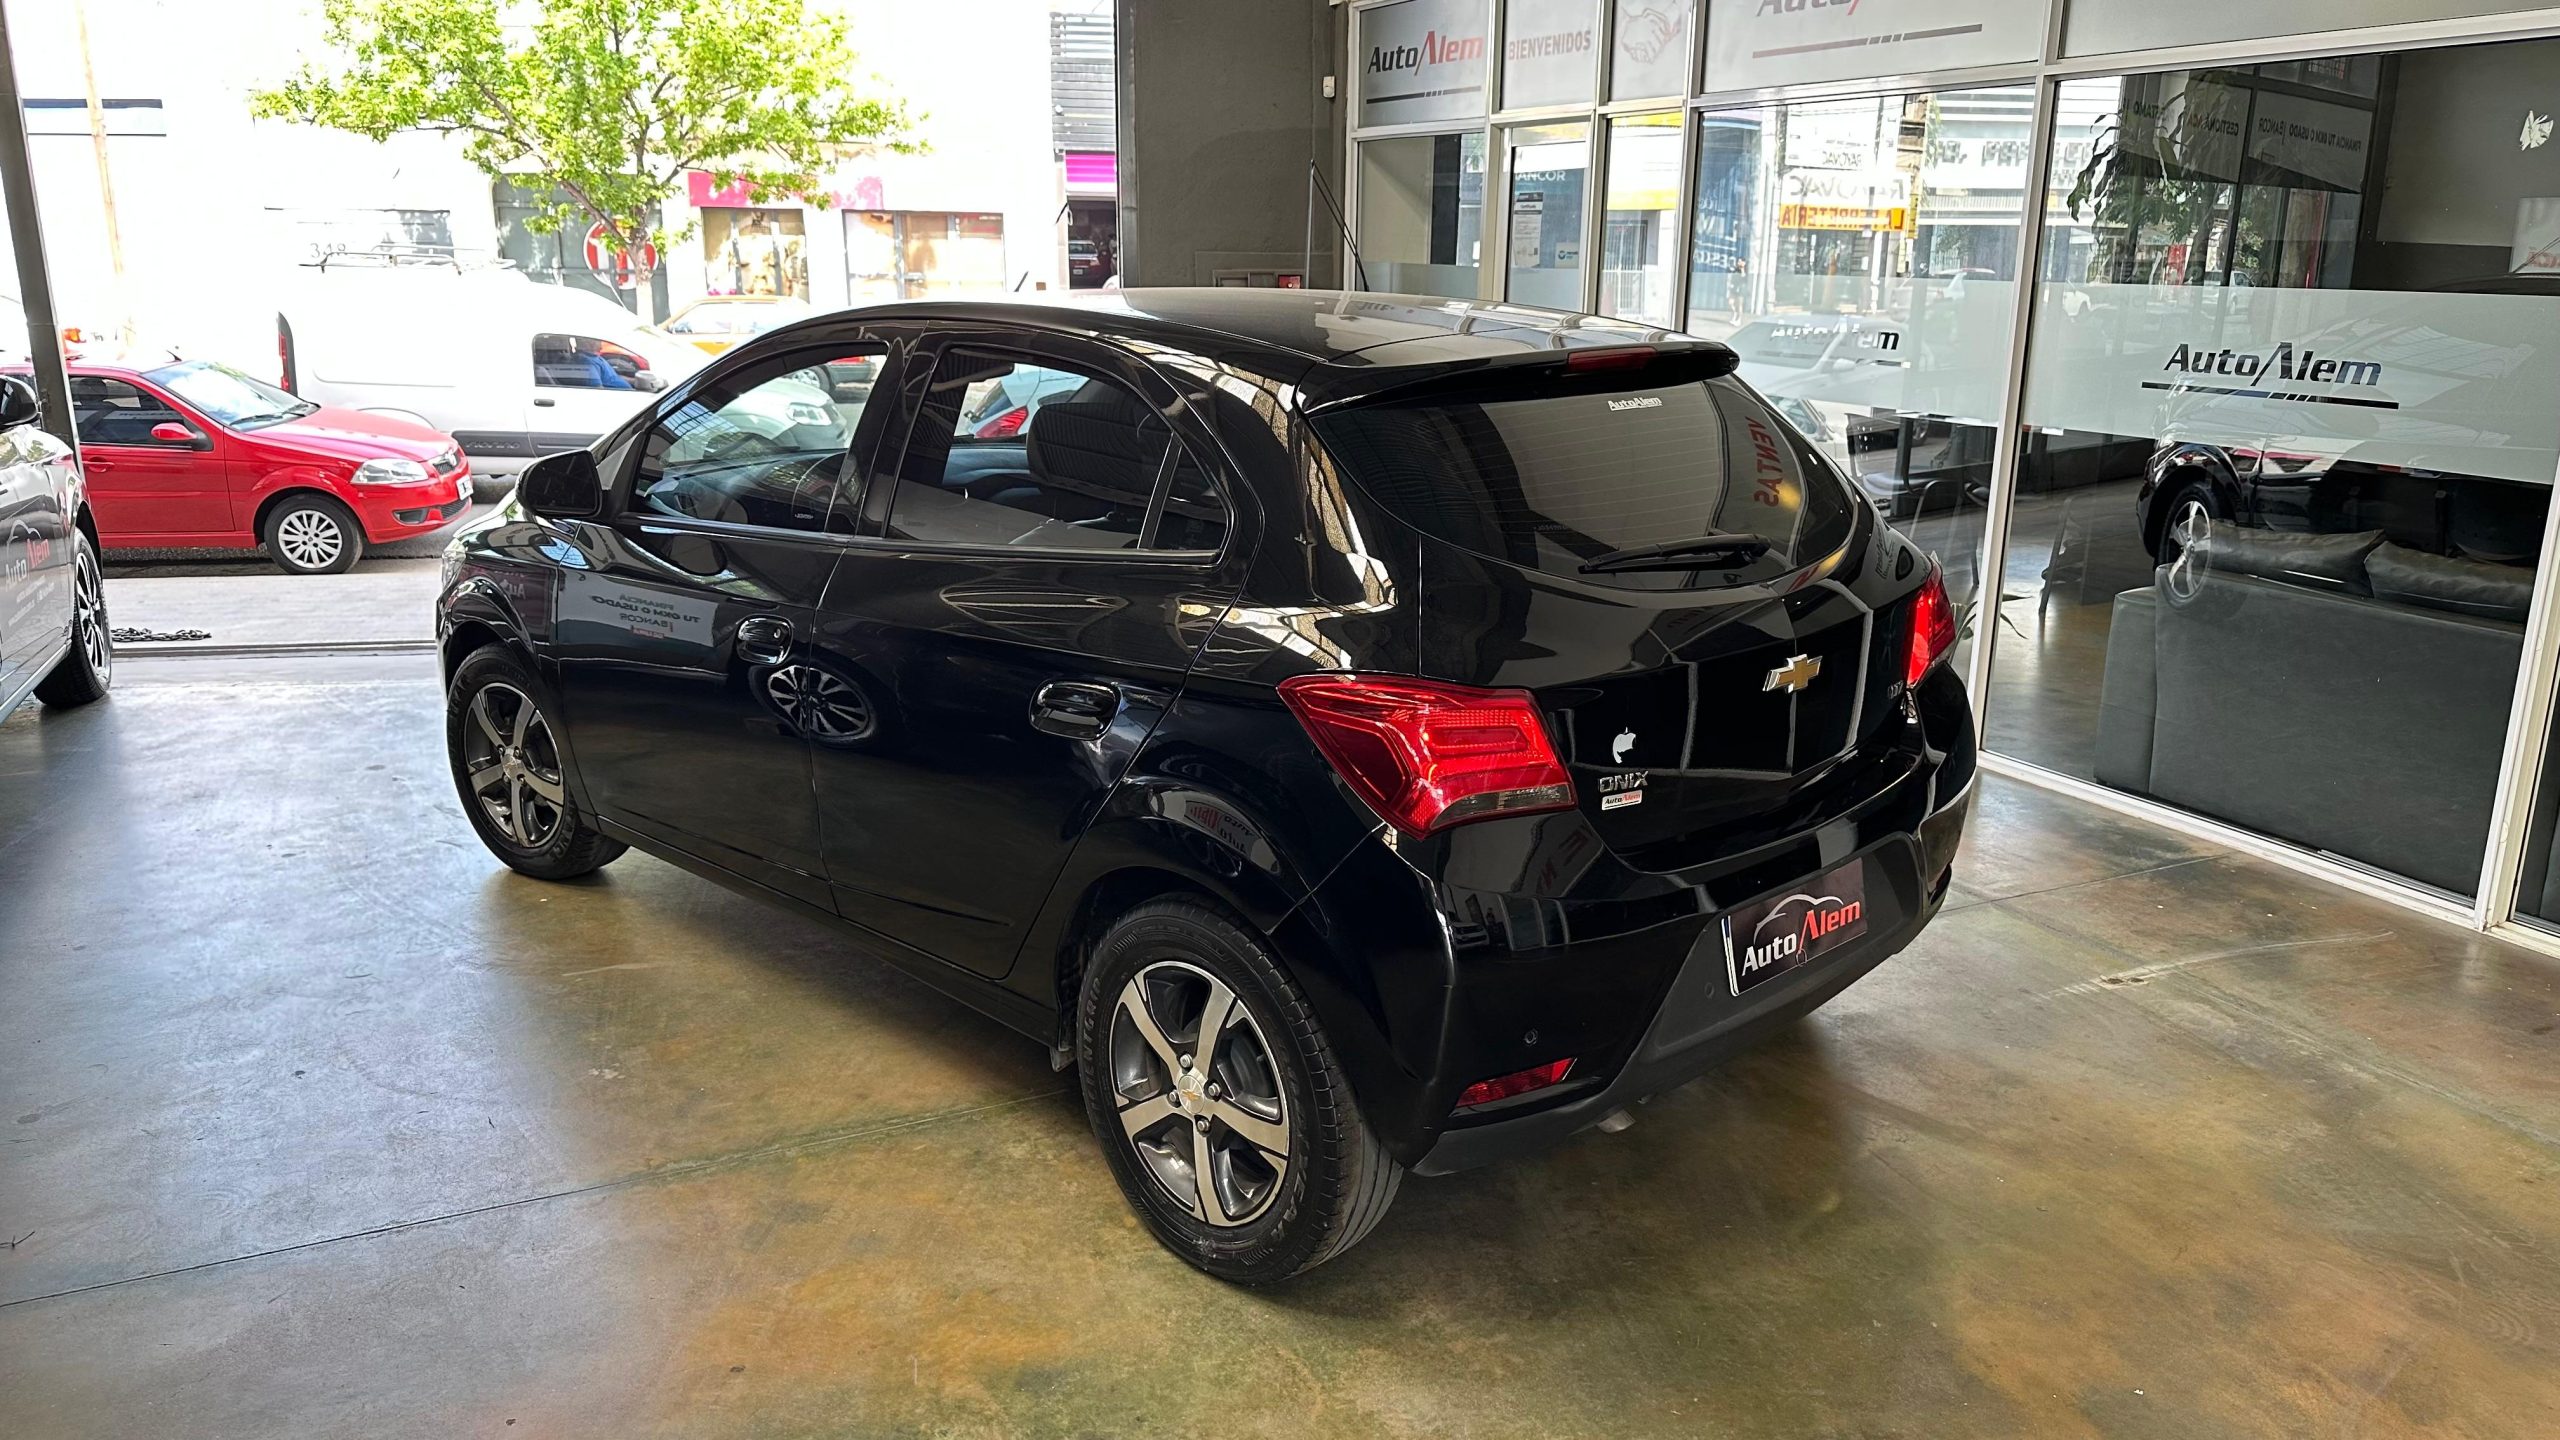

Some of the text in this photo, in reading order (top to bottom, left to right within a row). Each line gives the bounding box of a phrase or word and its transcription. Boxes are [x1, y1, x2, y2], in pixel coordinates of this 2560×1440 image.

[1508, 29, 1592, 61] BIENVENIDOS
[2164, 341, 2382, 387] AutoAlem
[1599, 770, 1649, 793] ONIX
[1741, 901, 1861, 977] AutoAlem
